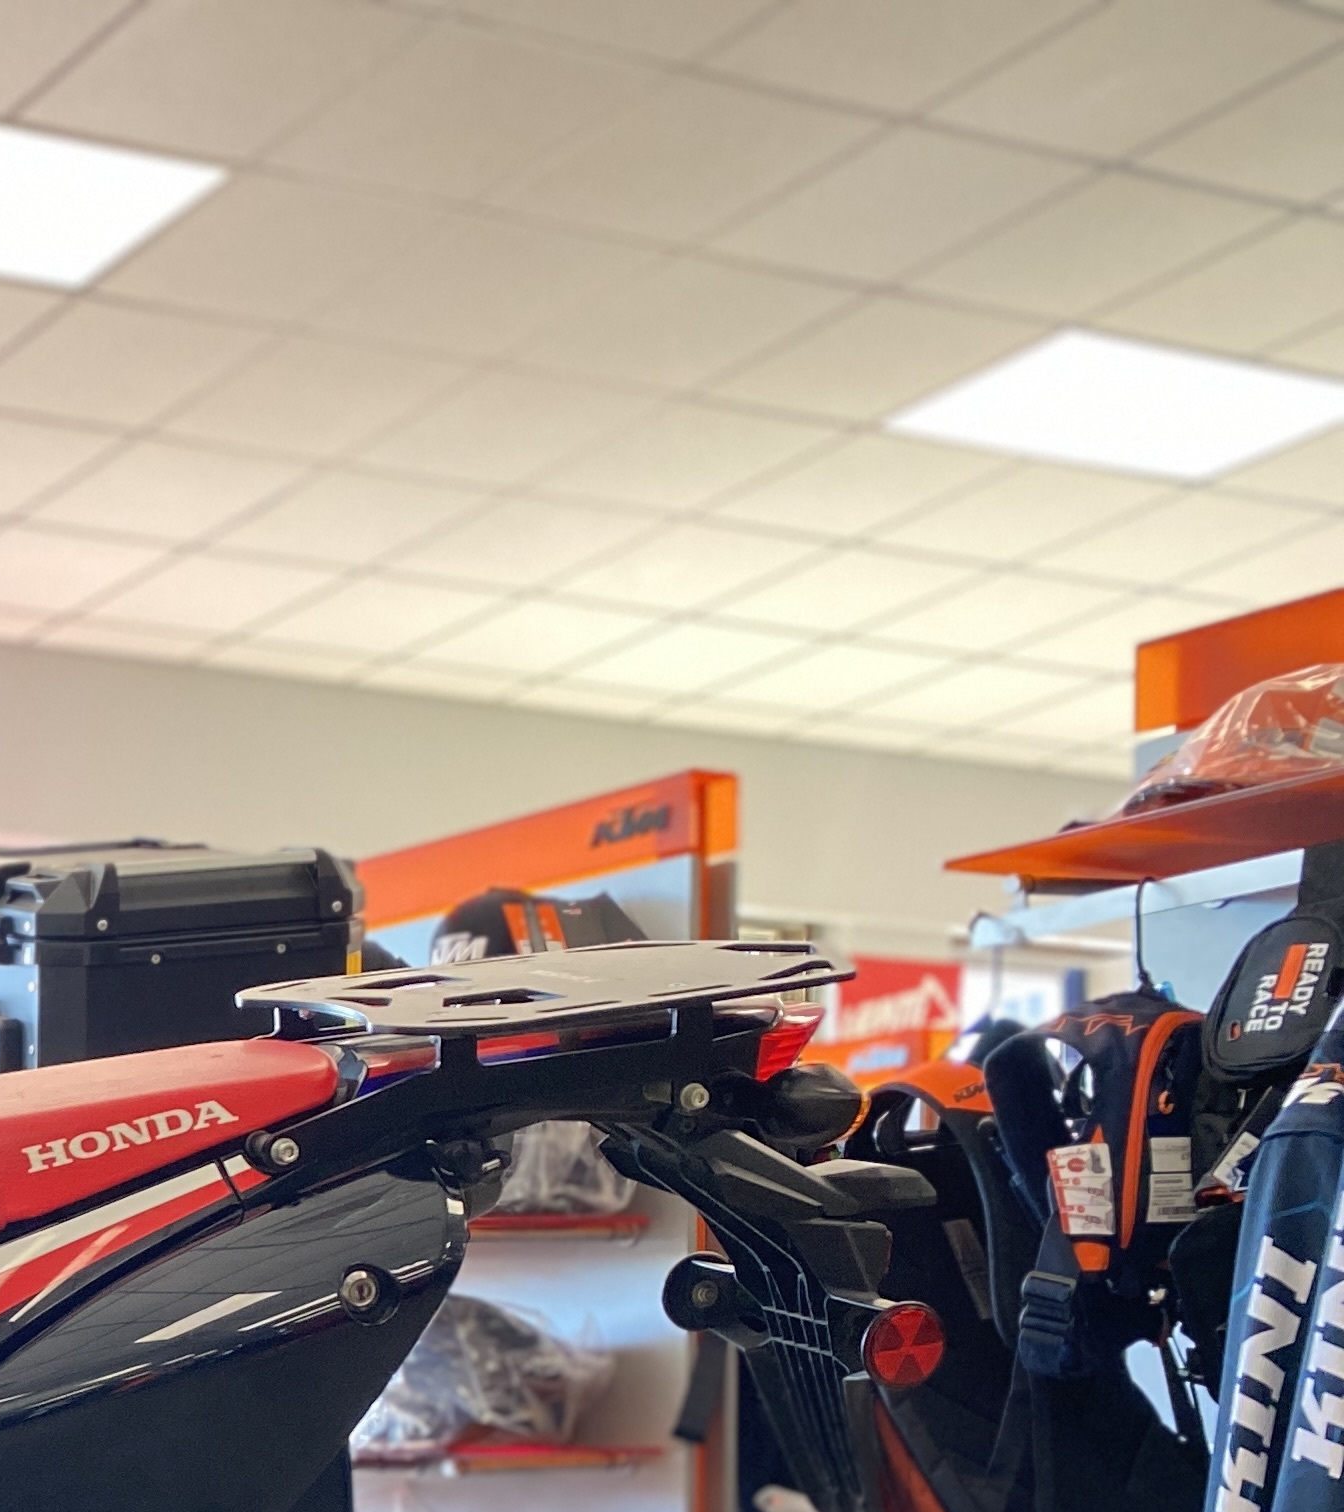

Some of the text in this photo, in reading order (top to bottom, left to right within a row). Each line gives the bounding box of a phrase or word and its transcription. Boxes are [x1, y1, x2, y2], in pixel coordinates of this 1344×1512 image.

[590, 805, 672, 848] KTM
[1244, 973, 1279, 1033] RACE
[1285, 942, 1330, 1016] READY
[1264, 1000, 1289, 1032] TO
[20, 1099, 240, 1174] HONDA
